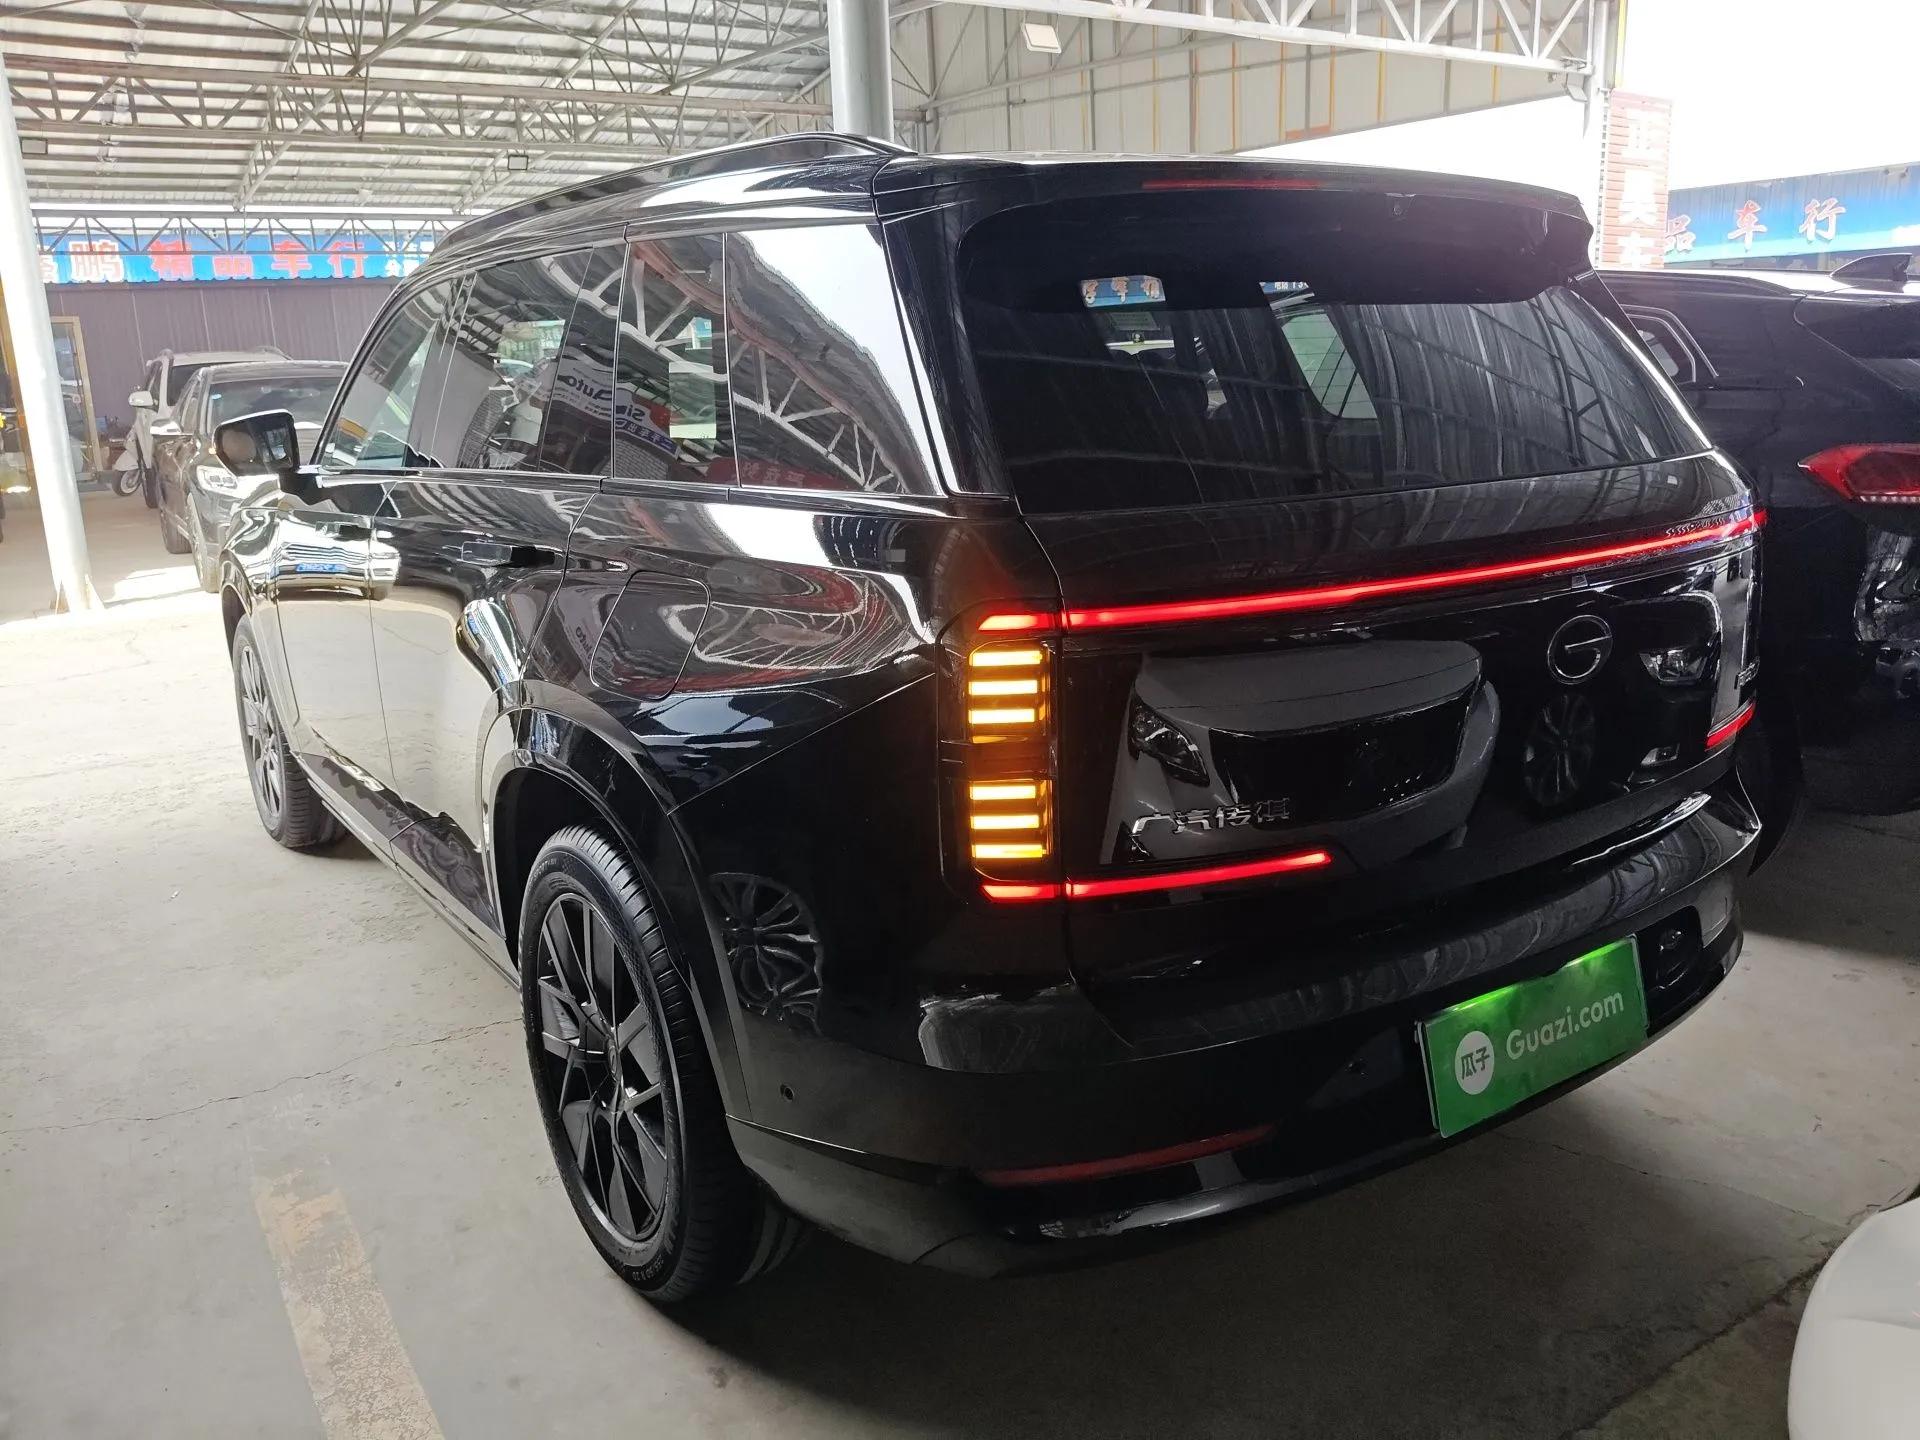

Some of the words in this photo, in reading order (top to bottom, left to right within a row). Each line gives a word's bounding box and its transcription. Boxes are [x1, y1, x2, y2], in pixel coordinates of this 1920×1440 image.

[1131, 797, 1291, 836] 广汽传祺
[1506, 991, 1625, 1061] Guazi.com
[1460, 1045, 1491, 1080] 瓜子
